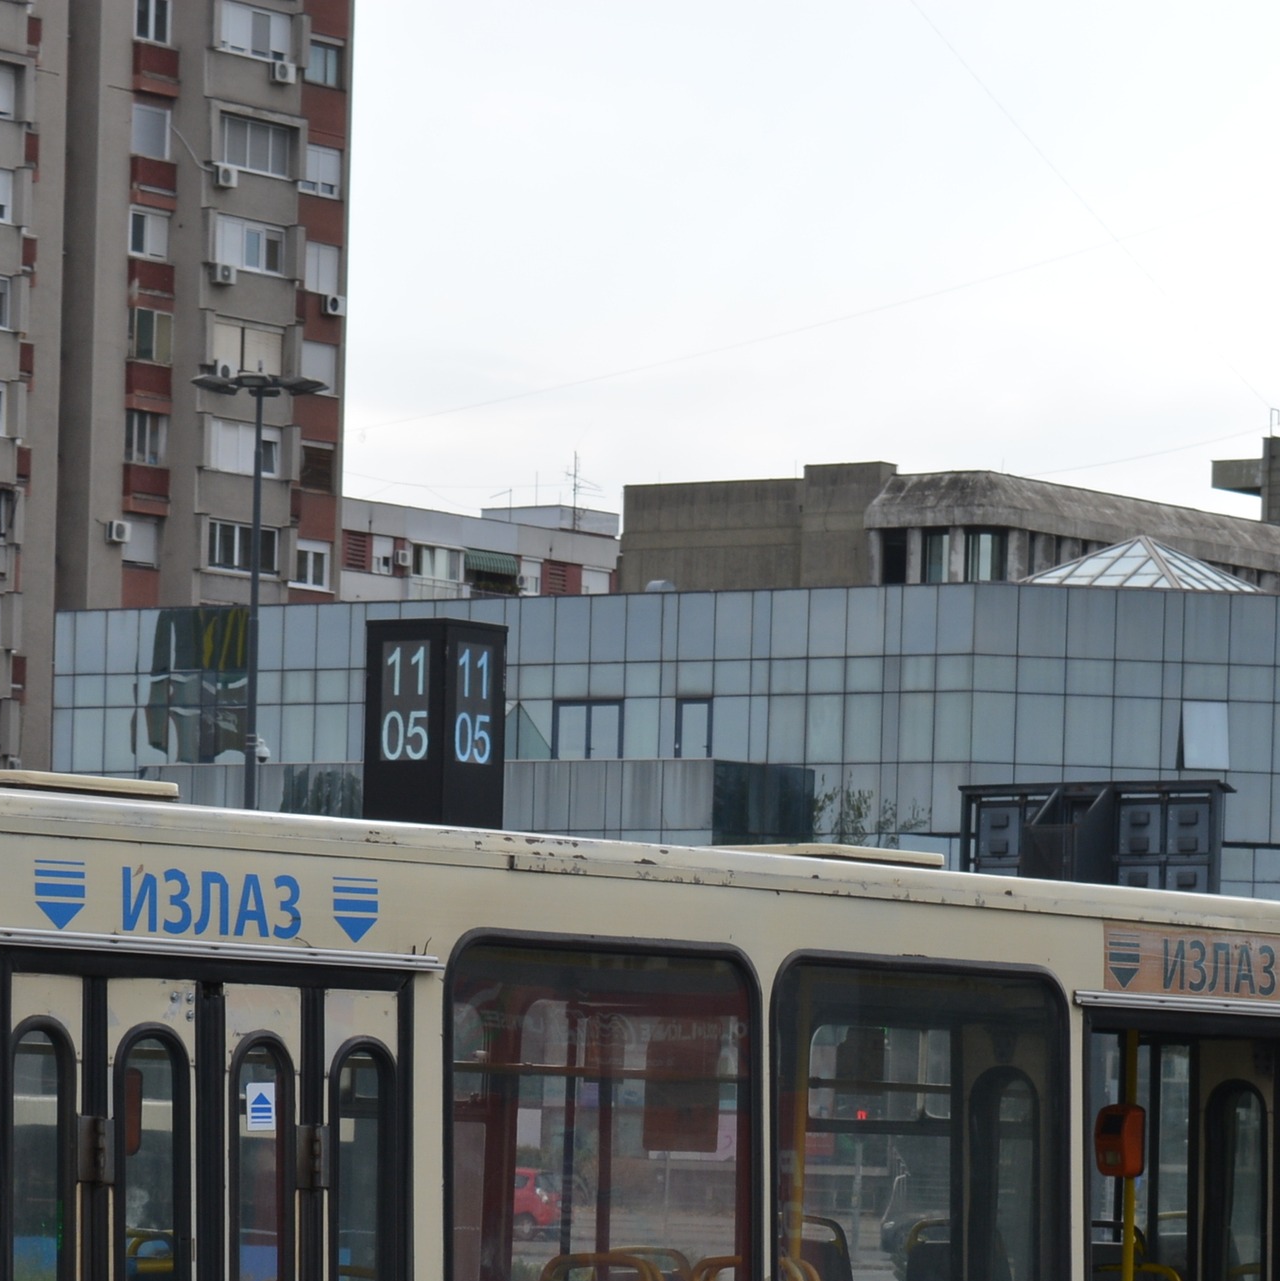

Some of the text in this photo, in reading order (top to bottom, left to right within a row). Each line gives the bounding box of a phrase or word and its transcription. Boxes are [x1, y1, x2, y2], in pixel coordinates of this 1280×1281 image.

[386, 645, 425, 697] 11
[458, 647, 489, 701] 11
[381, 709, 429, 762] 05
[454, 713, 491, 765] 05
[121, 865, 302, 940] ИЗЛАЗ
[1161, 937, 1277, 997] ИЗЛАЗ
